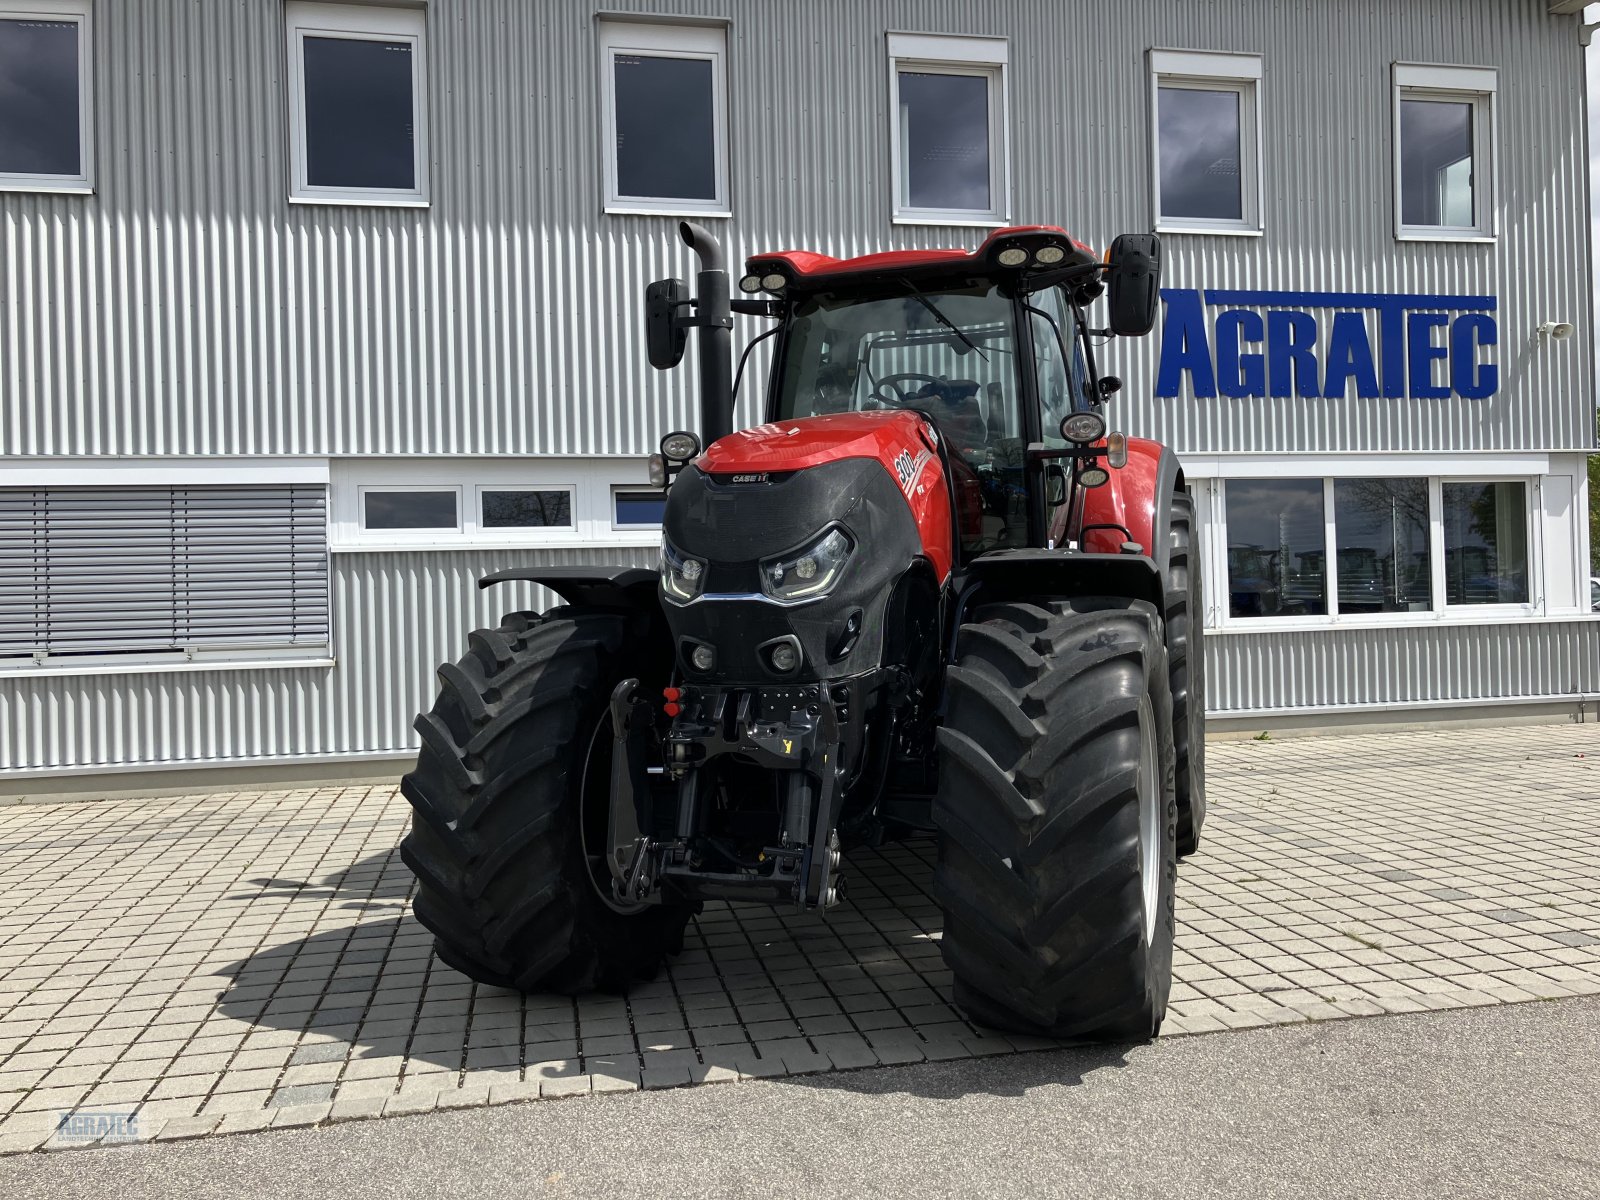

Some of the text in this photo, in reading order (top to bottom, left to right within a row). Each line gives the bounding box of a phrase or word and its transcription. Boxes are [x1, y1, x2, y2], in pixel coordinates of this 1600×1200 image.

[1156, 288, 1498, 400] AGRATEC
[732, 475, 757, 483] CASE
[895, 449, 916, 484] 300
